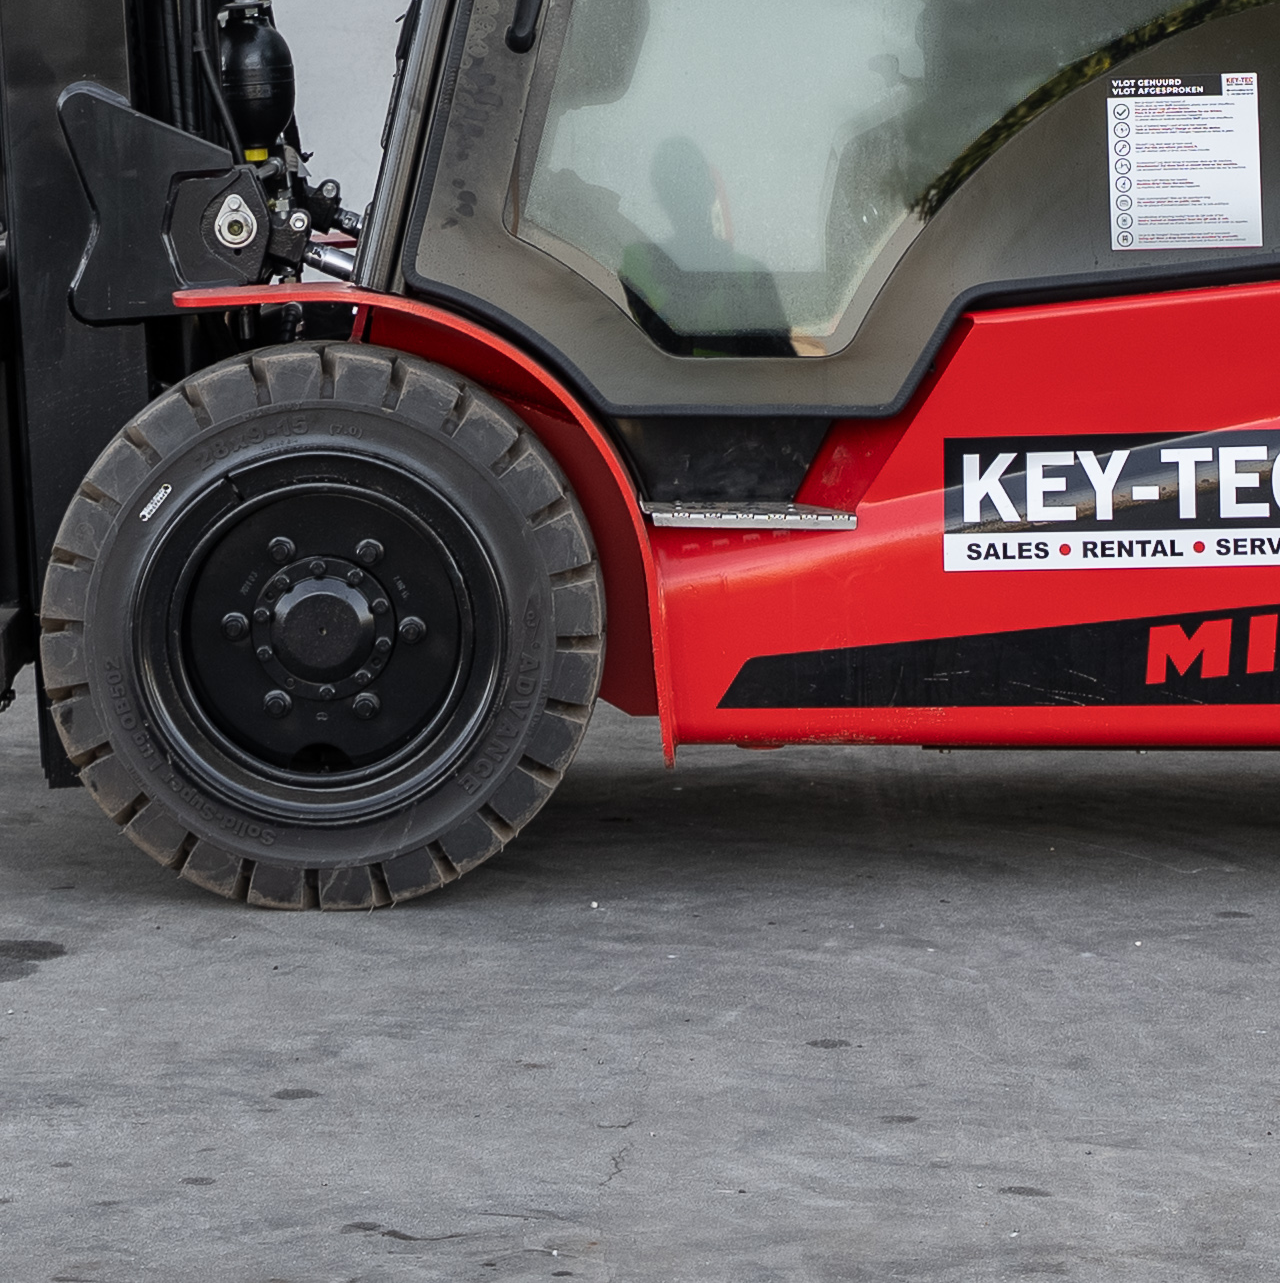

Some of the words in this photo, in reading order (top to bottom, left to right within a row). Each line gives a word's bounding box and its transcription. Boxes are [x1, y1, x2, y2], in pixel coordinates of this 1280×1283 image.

[1111, 79, 1136, 87] VLOT
[1137, 78, 1182, 87] GENUURD
[1111, 87, 1136, 95] VLOT
[1137, 86, 1204, 95] AFGESPROKEN
[1226, 76, 1253, 84] KEY-TEC
[195, 415, 309, 472] 28x9-15
[329, 423, 364, 440] (7.0)
[966, 541, 1050, 562] SALES
[1082, 538, 1184, 560] RENTAL
[1145, 614, 1279, 686] MI
[104, 657, 137, 732] OB502
[458, 652, 540, 796] ADVANCE
[131, 731, 164, 772] Lug
[160, 771, 278, 848] Solid-Super
